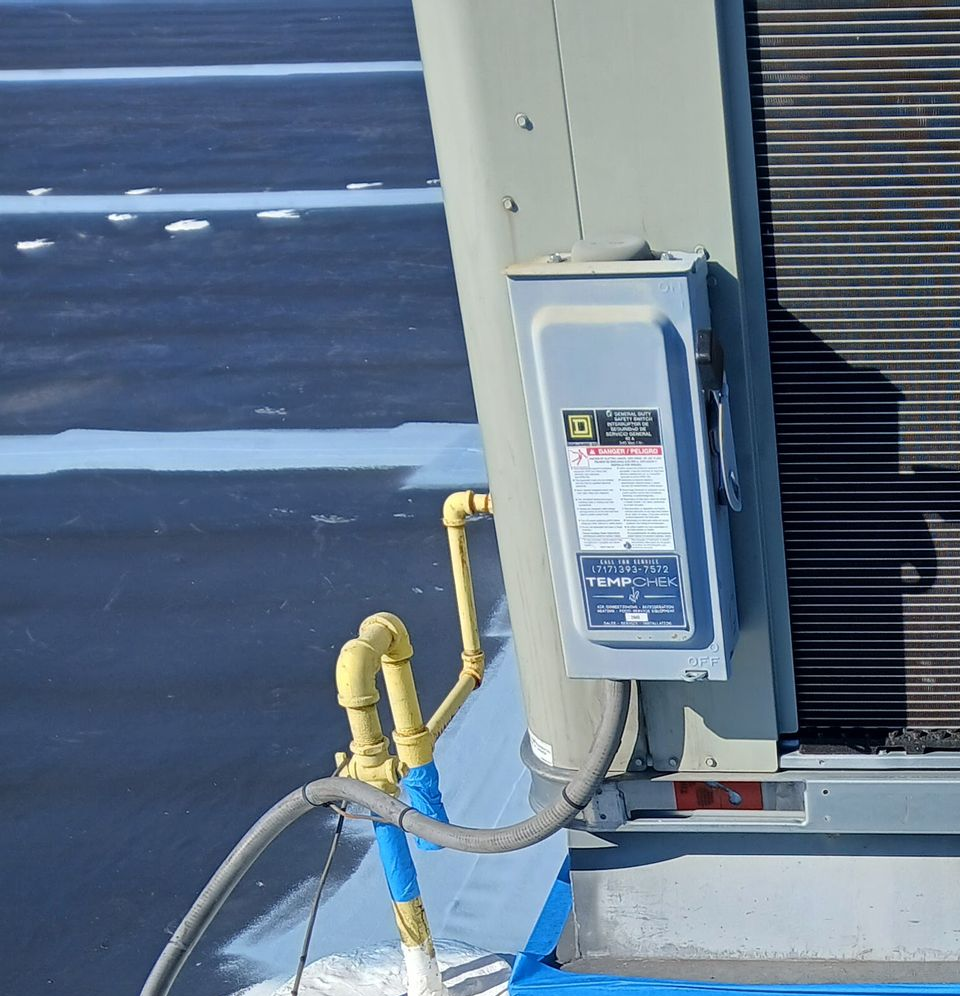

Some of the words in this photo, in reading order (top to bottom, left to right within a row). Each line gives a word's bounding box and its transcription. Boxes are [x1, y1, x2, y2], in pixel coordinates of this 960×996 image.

[591, 565, 669, 574] (717)393-7572
[585, 577, 678, 587] TEMPCHEK
[688, 656, 720, 667] OFF
